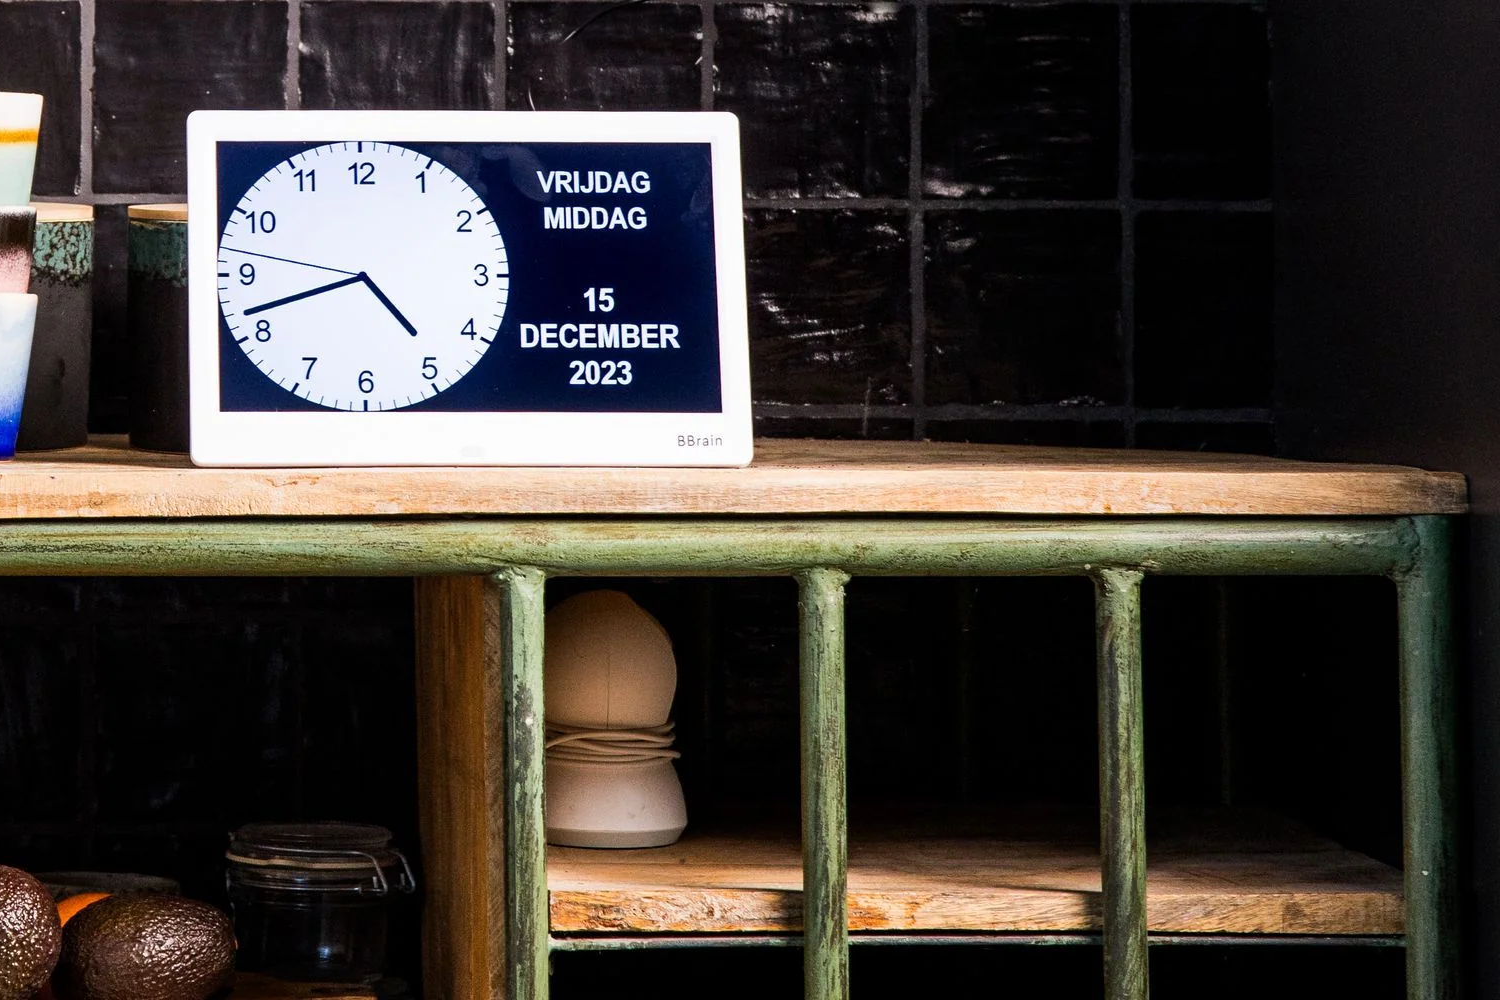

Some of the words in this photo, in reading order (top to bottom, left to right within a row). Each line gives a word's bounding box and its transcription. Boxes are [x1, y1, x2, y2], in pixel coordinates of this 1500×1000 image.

[292, 168, 316, 193] 11
[347, 161, 376, 186] 12
[414, 170, 426, 194] 1
[536, 170, 651, 194] VRIJDAG
[244, 210, 277, 235] 10
[456, 209, 473, 233] 2
[543, 206, 648, 230] MIDDAG
[238, 262, 256, 287] 9
[473, 263, 490, 287] 3
[583, 287, 615, 313] 15
[254, 319, 272, 343] 8
[460, 317, 478, 341] 4
[520, 323, 681, 349] DECEMBER
[301, 356, 319, 381] 7
[421, 356, 439, 381] 5
[569, 360, 633, 385] 2023
[357, 369, 375, 394] 6
[677, 434, 723, 447] BBrain
